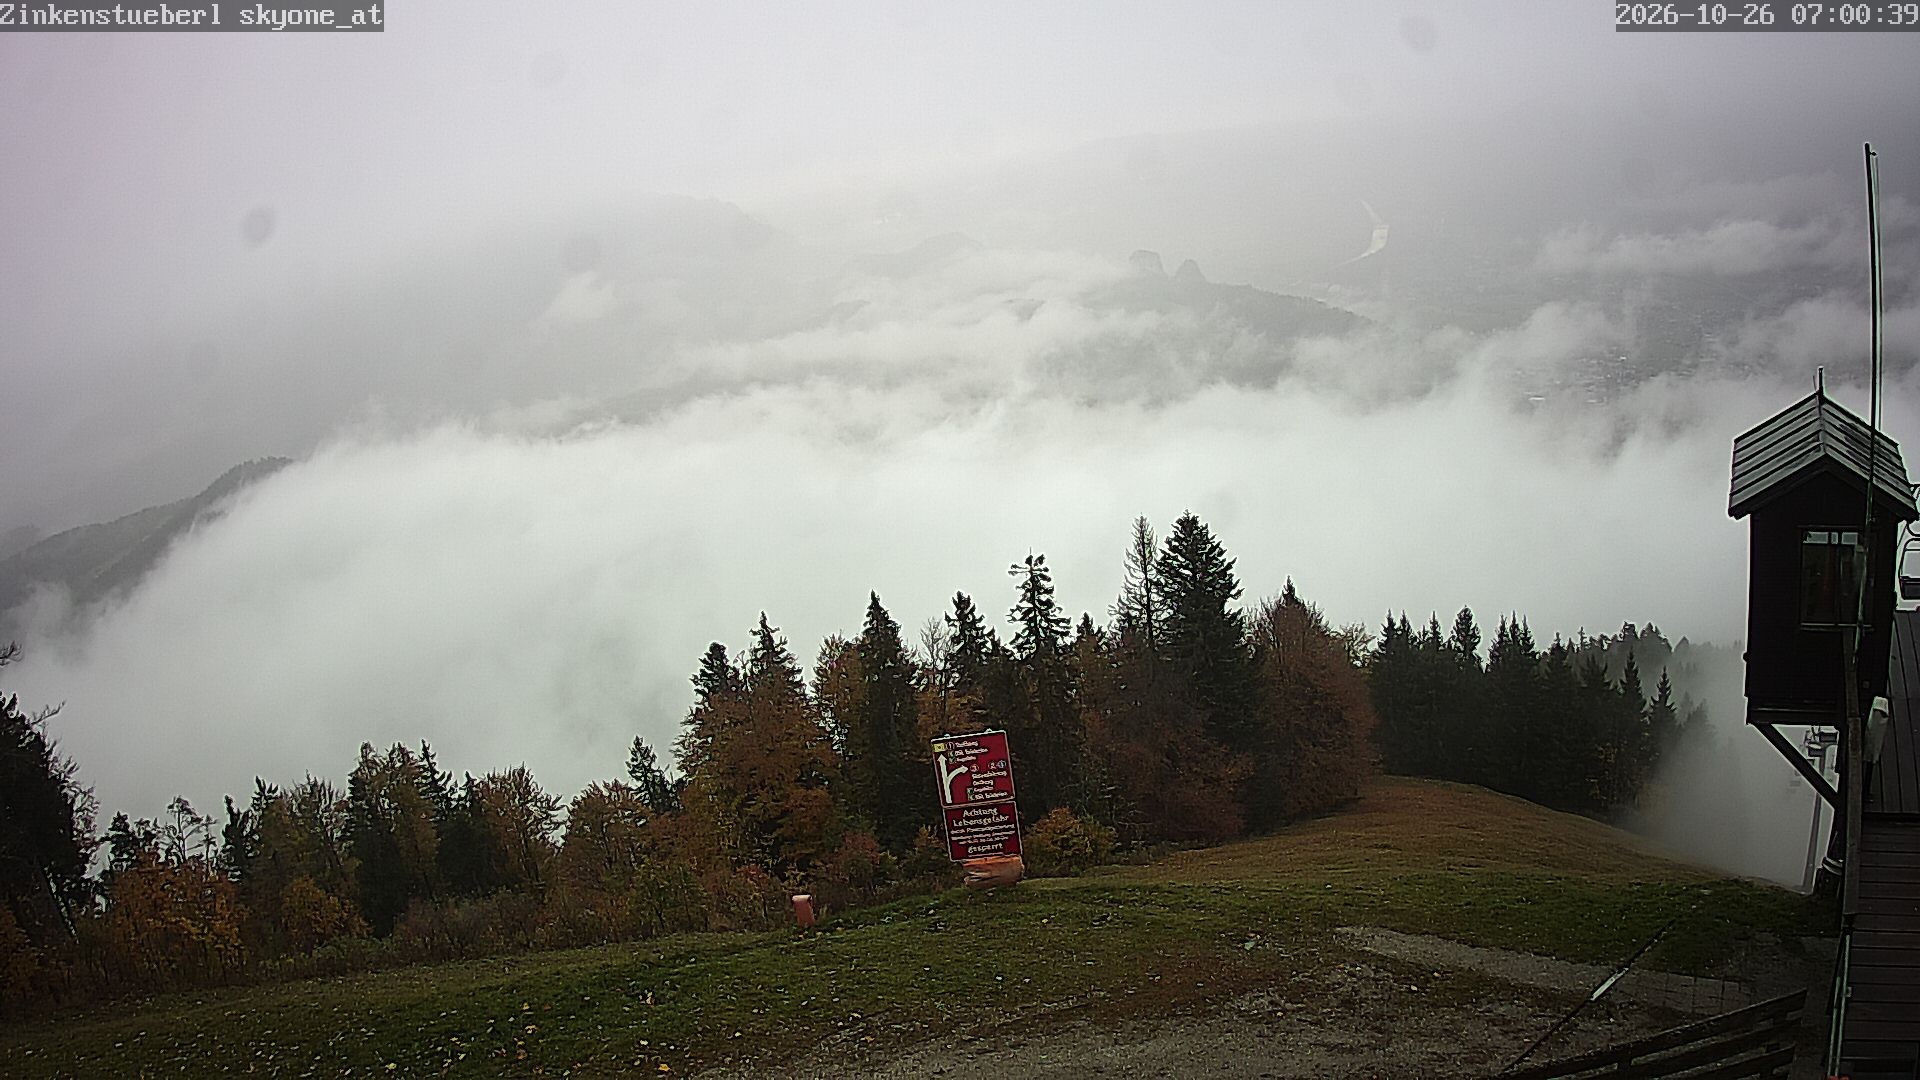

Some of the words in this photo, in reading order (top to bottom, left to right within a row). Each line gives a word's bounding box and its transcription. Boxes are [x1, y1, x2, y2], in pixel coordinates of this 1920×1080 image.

[963, 807, 998, 817] Achtung
[953, 815, 1009, 827] Lebensgefahr
[967, 843, 1003, 853] gesperrt
